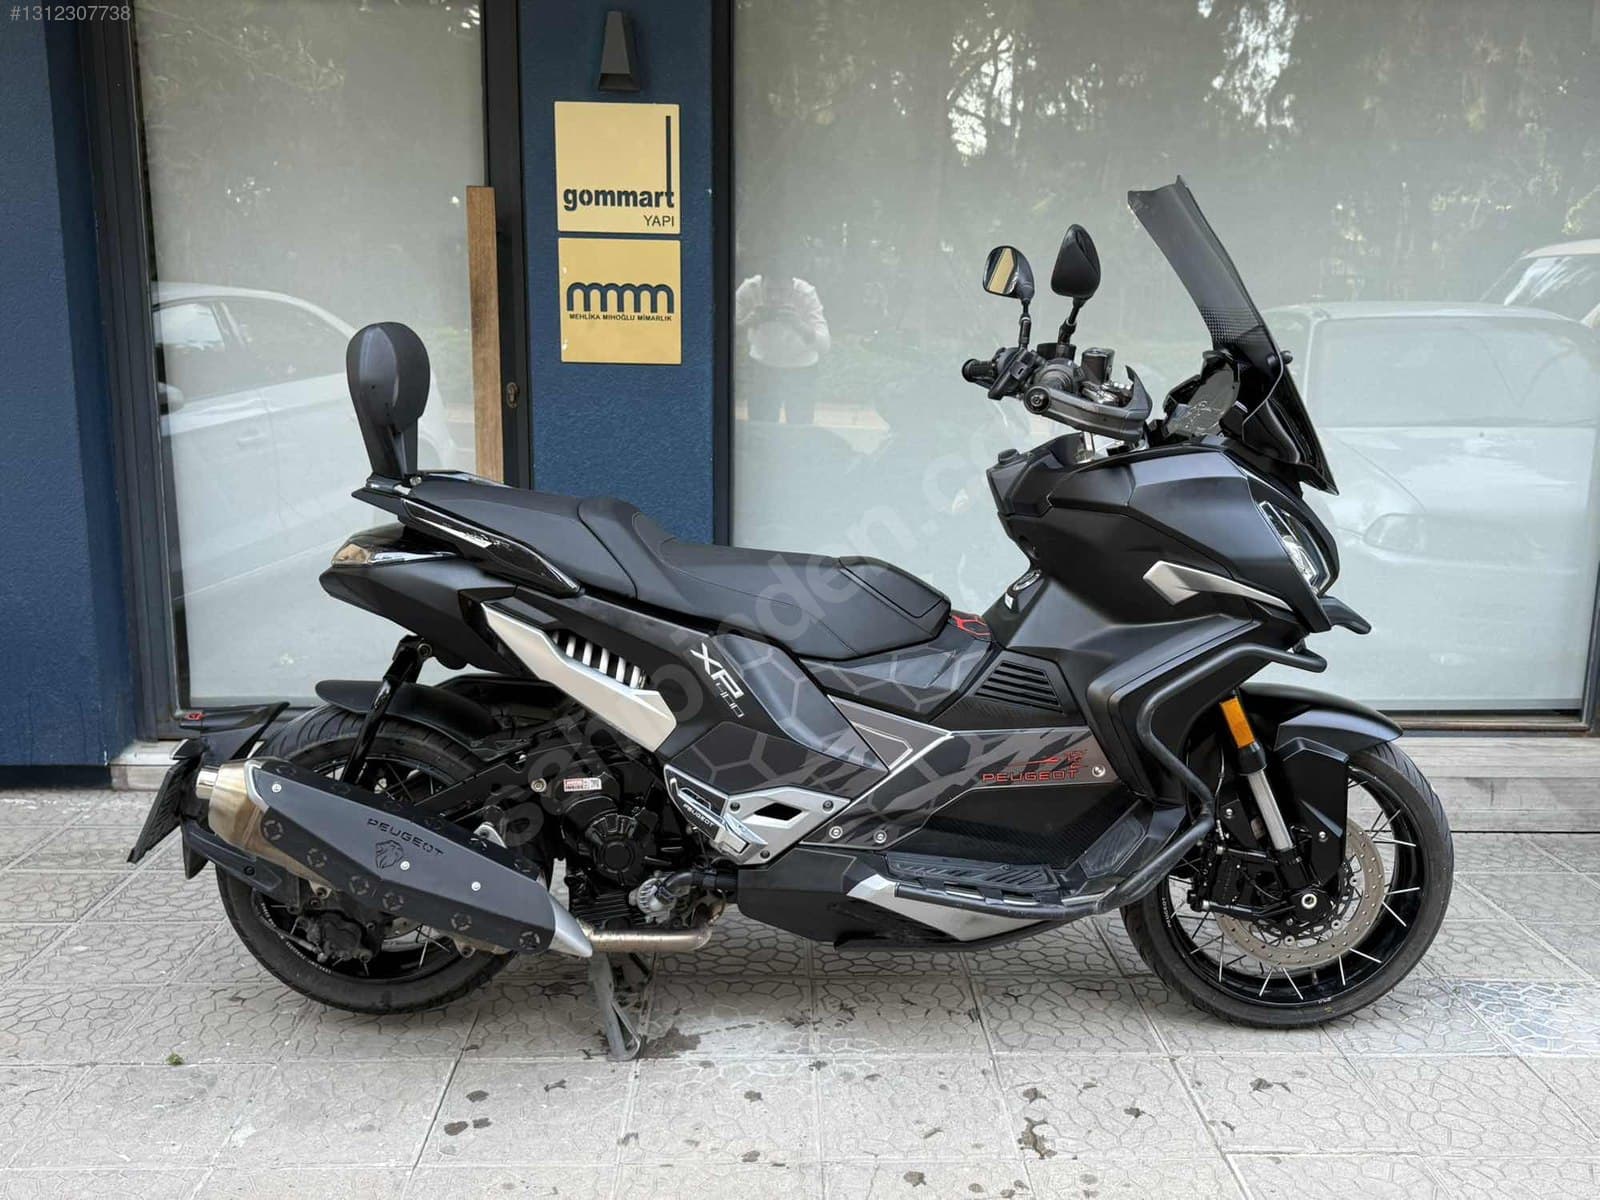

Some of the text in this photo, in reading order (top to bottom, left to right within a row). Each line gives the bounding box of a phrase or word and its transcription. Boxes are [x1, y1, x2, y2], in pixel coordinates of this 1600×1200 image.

[563, 188, 674, 211] gommart
[643, 215, 675, 228] YAPI
[690, 642, 744, 699] XP
[982, 769, 1077, 782] PEUGEOT
[683, 803, 714, 827] PEUGEOT
[367, 818, 445, 855] PEUGEOT
